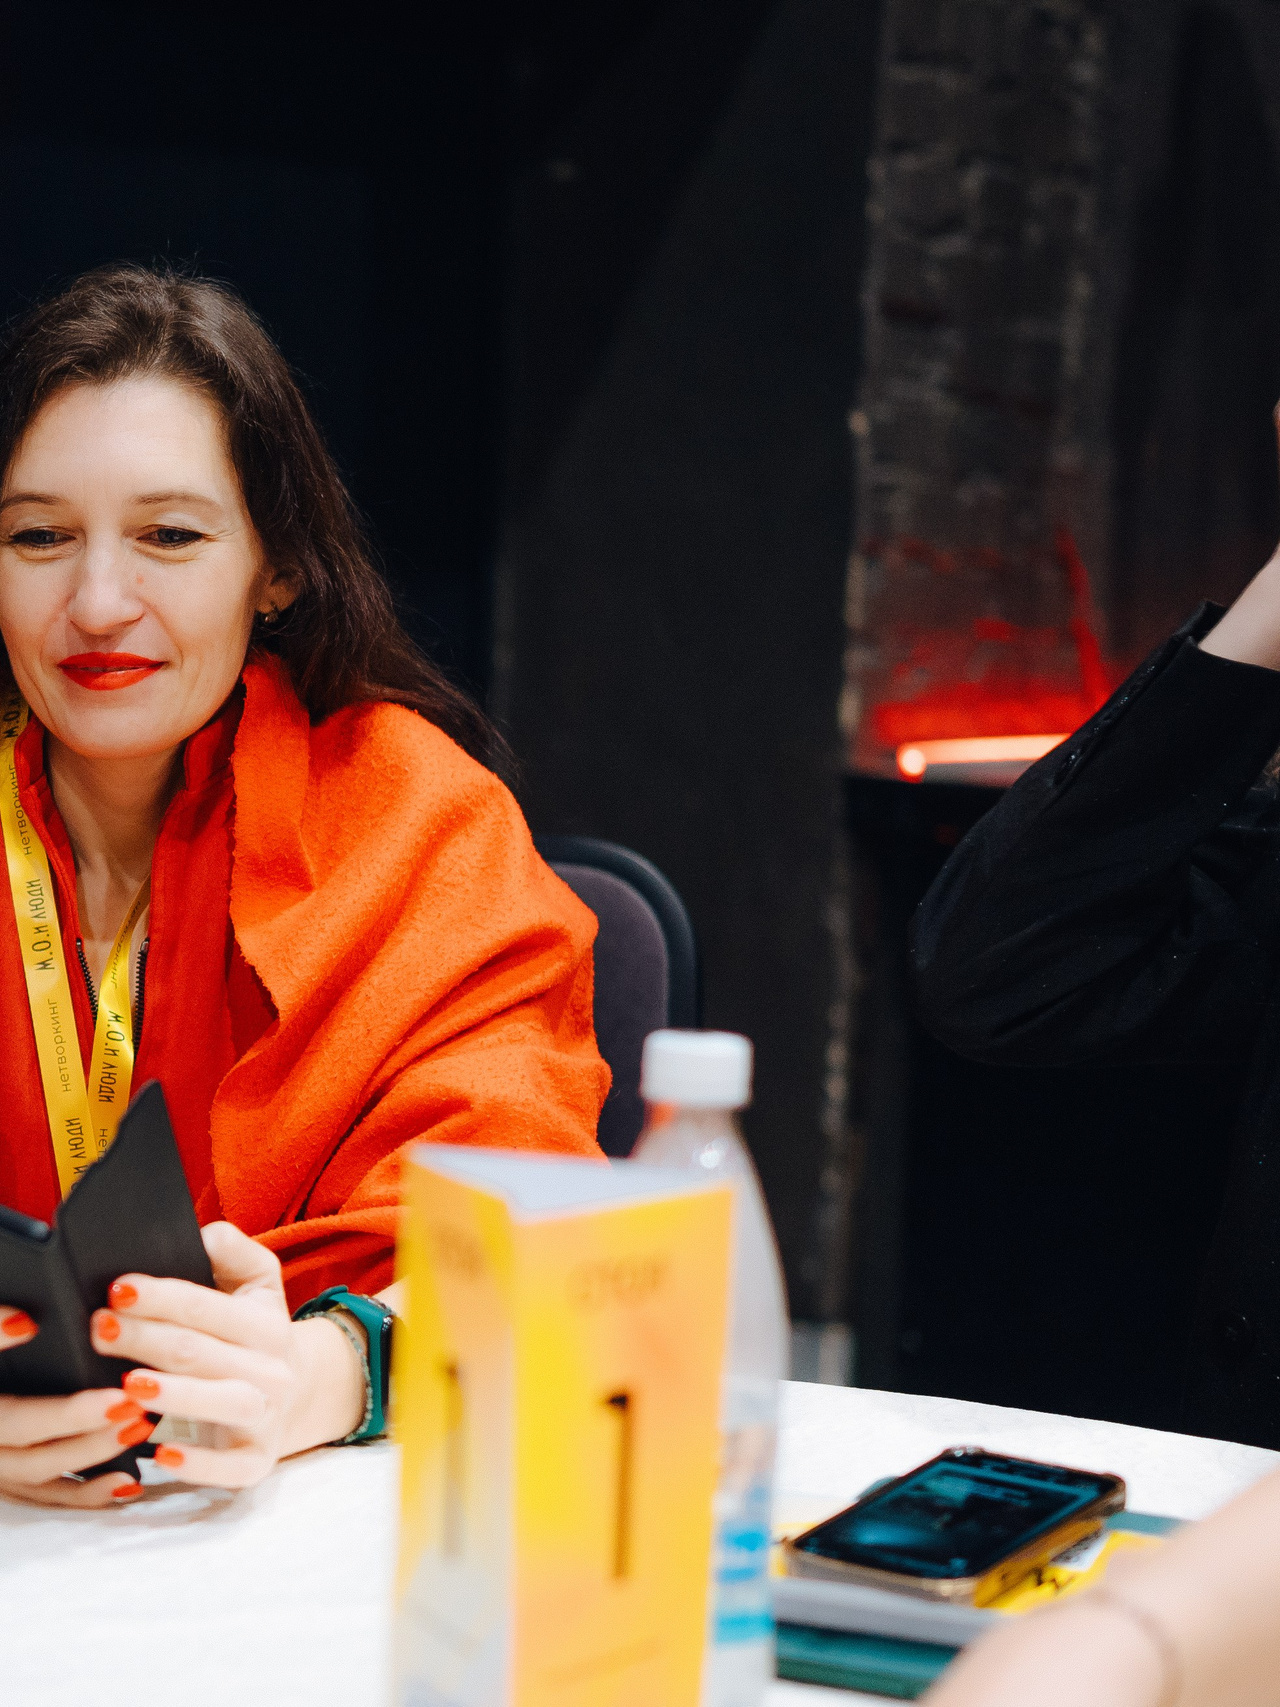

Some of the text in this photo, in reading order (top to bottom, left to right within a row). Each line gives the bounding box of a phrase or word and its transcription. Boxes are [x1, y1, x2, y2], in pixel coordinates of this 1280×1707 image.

[26, 878, 47, 919] ЛЮДИ
[47, 998, 72, 1092] нетворкинг
[98, 1061, 118, 1103] ЛЮДИ
[64, 1117, 87, 1159] ЛЮДИ
[98, 1128, 108, 1159] нет
[603, 1387, 633, 1582] 1
